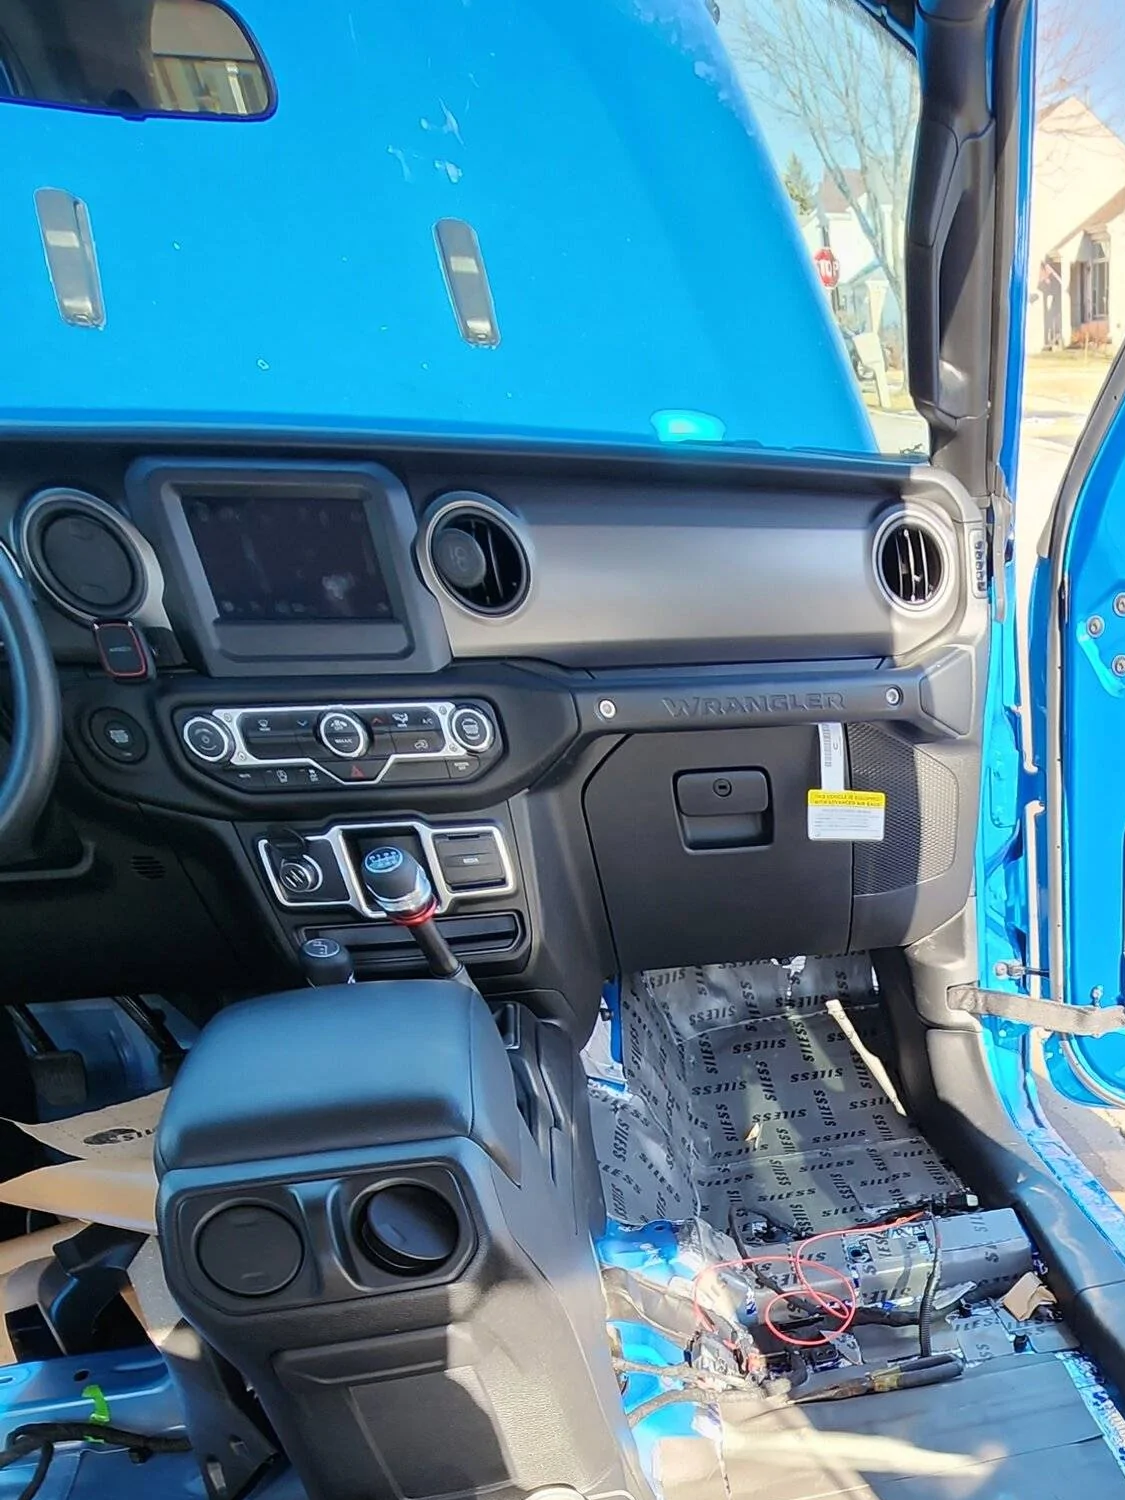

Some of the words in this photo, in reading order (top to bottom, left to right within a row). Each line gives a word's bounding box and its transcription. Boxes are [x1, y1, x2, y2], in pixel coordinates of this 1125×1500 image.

[661, 692, 846, 718] WRANGLER
[689, 1005, 737, 1026] SILESS
[732, 1038, 787, 1055] SILESS
[793, 1021, 815, 1062] SILESS
[756, 1060, 777, 1101] SILESS
[790, 1067, 844, 1083] SILESS
[691, 1080, 747, 1096] SILESS
[813, 1089, 837, 1127] SILESS
[849, 1096, 893, 1110] ILESS
[716, 1103, 739, 1142] SILESS
[752, 1108, 807, 1123] SILESS
[613, 1118, 630, 1162] SILESS
[811, 1129, 866, 1144] SILESS
[798, 1160, 855, 1173] SILESS
[860, 1171, 912, 1187] SILESS
[758, 1187, 816, 1202] SILESS
